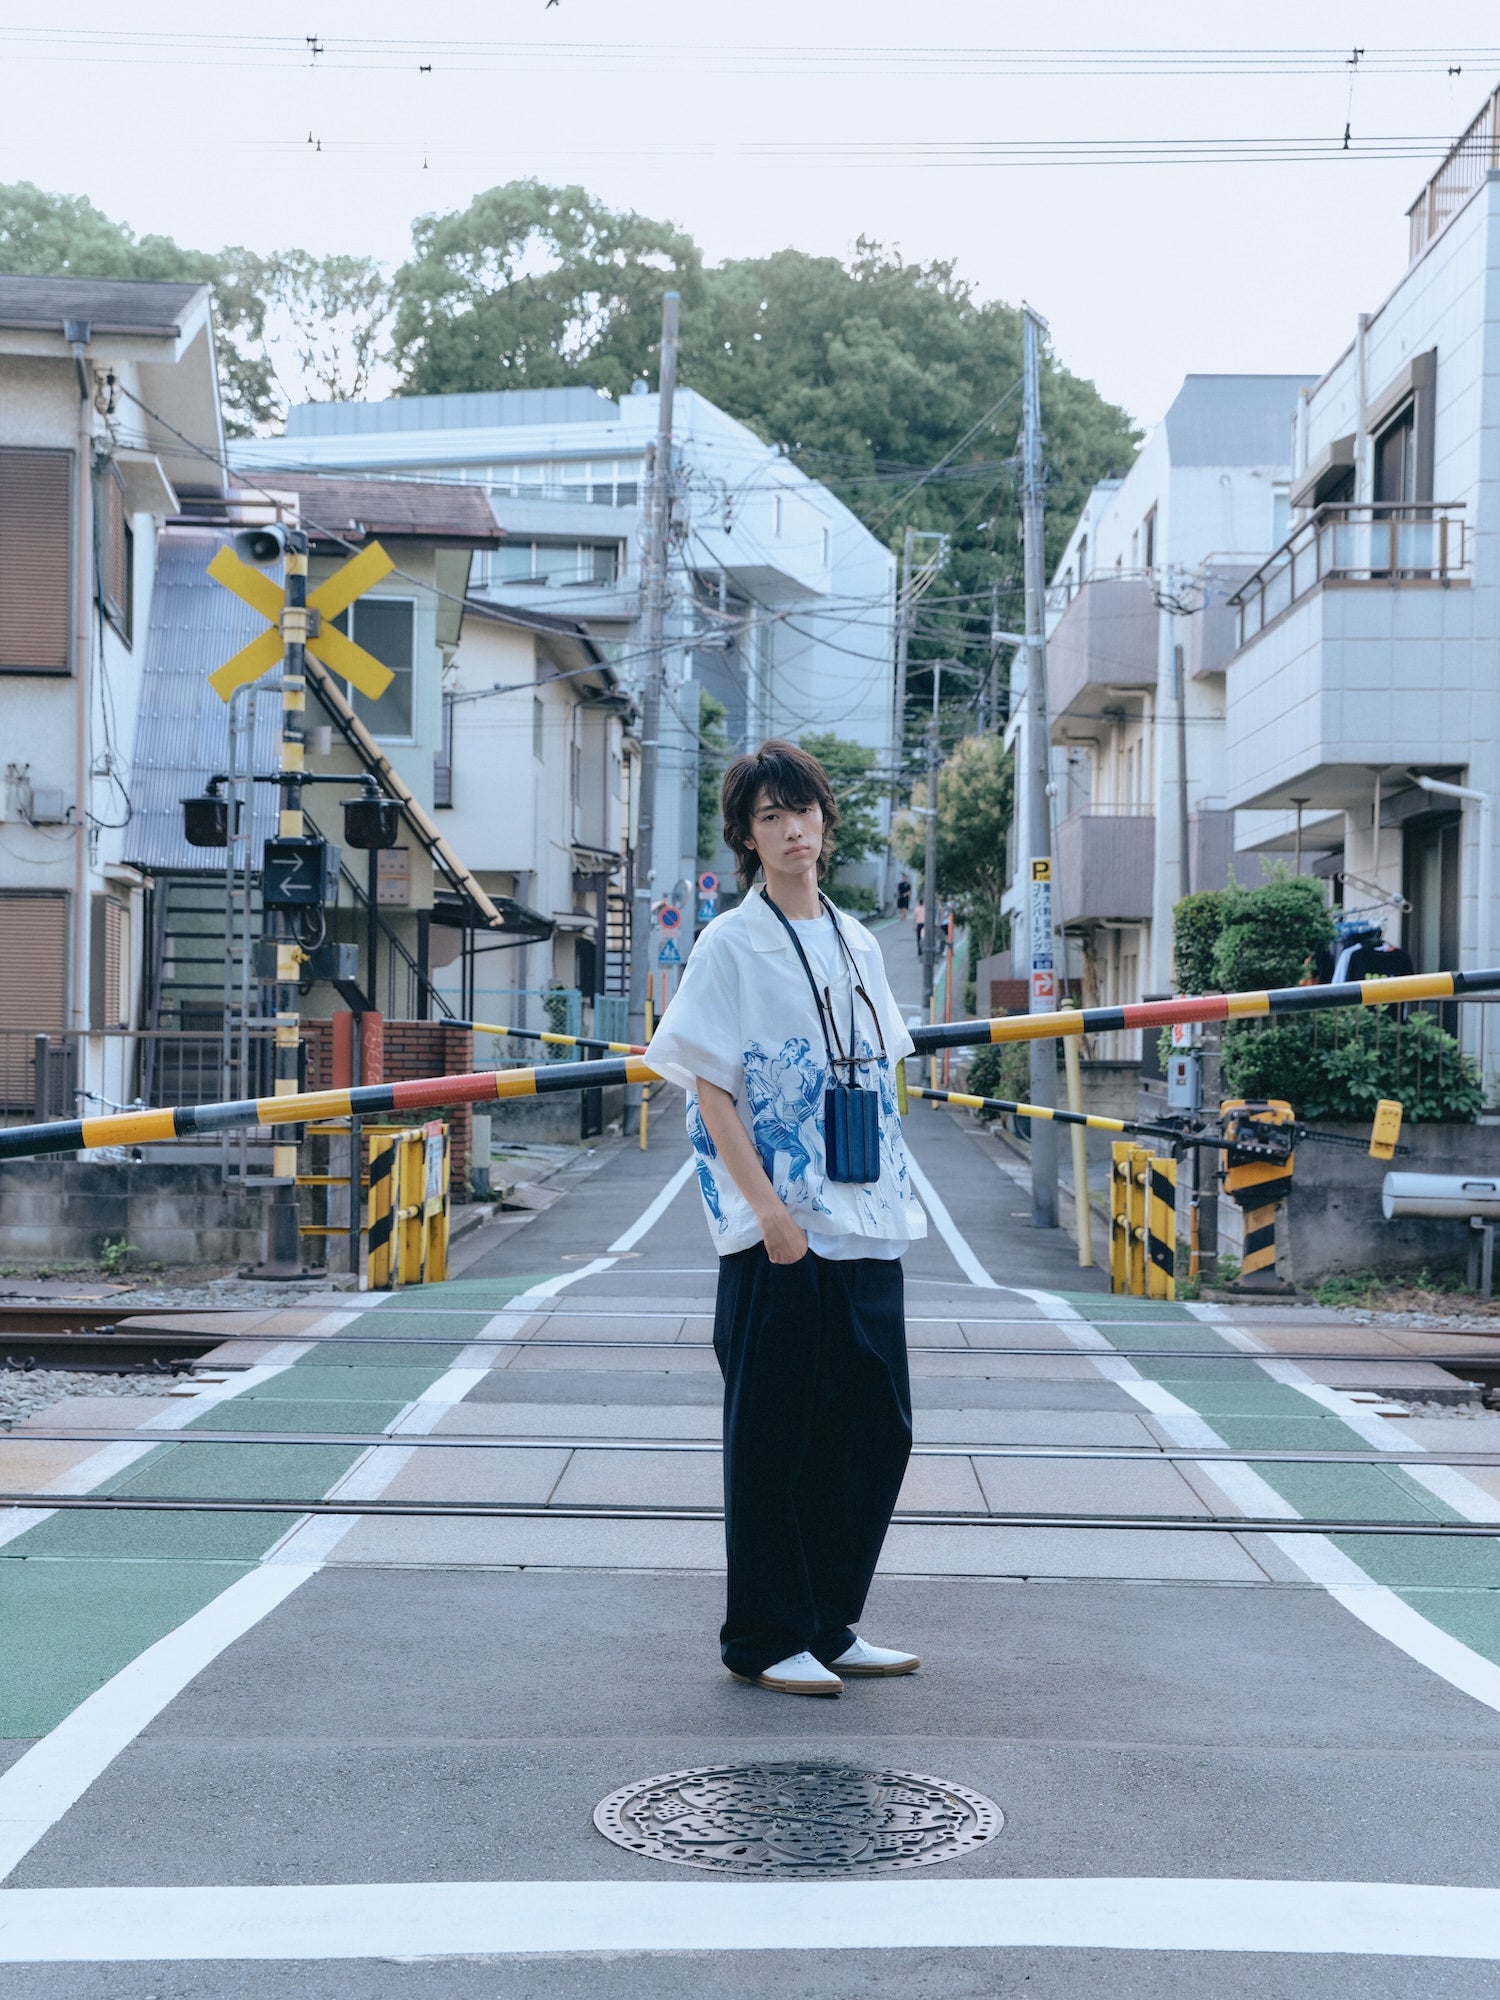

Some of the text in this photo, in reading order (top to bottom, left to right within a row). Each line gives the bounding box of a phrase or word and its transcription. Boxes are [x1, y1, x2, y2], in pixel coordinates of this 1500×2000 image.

[1032, 861, 1049, 880] P
[1032, 883, 1042, 952] コインパーキング
